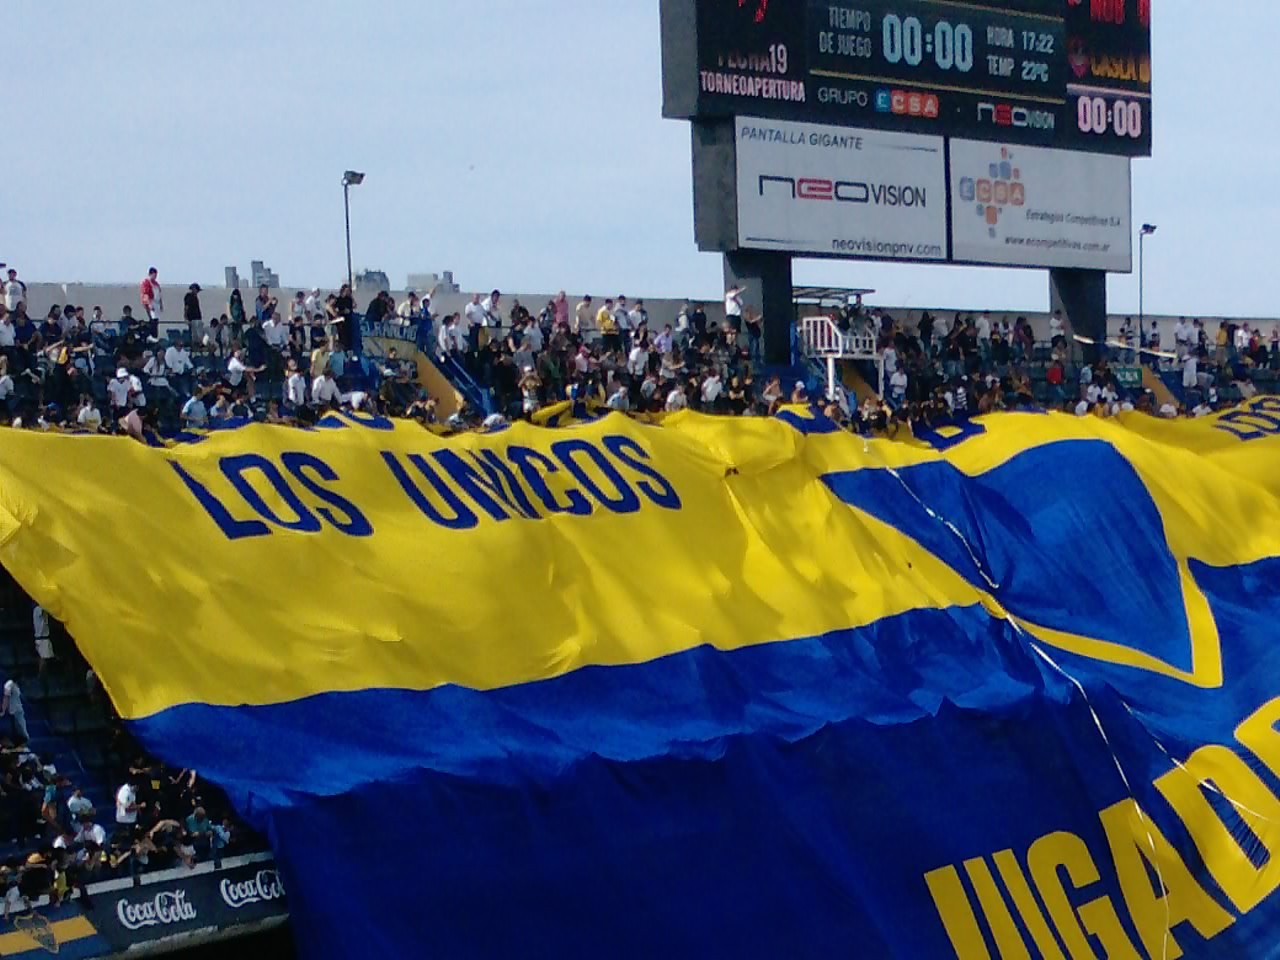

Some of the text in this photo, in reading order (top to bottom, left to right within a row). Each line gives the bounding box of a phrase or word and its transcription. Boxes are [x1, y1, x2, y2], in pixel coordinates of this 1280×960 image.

[828, 6, 872, 33] TIEMPO
[818, 31, 873, 58] DE JUEGO
[882, 13, 973, 72] 00:00
[986, 25, 1015, 48] HORA
[986, 56, 1015, 77] TEMP
[817, 87, 868, 107] GRUPO
[1077, 96, 1142, 138] 00:00
[741, 126, 864, 150] PANTALLA GIGANTE
[832, 237, 942, 257] neovisionpnv.com
[166, 450, 375, 540] LOS
